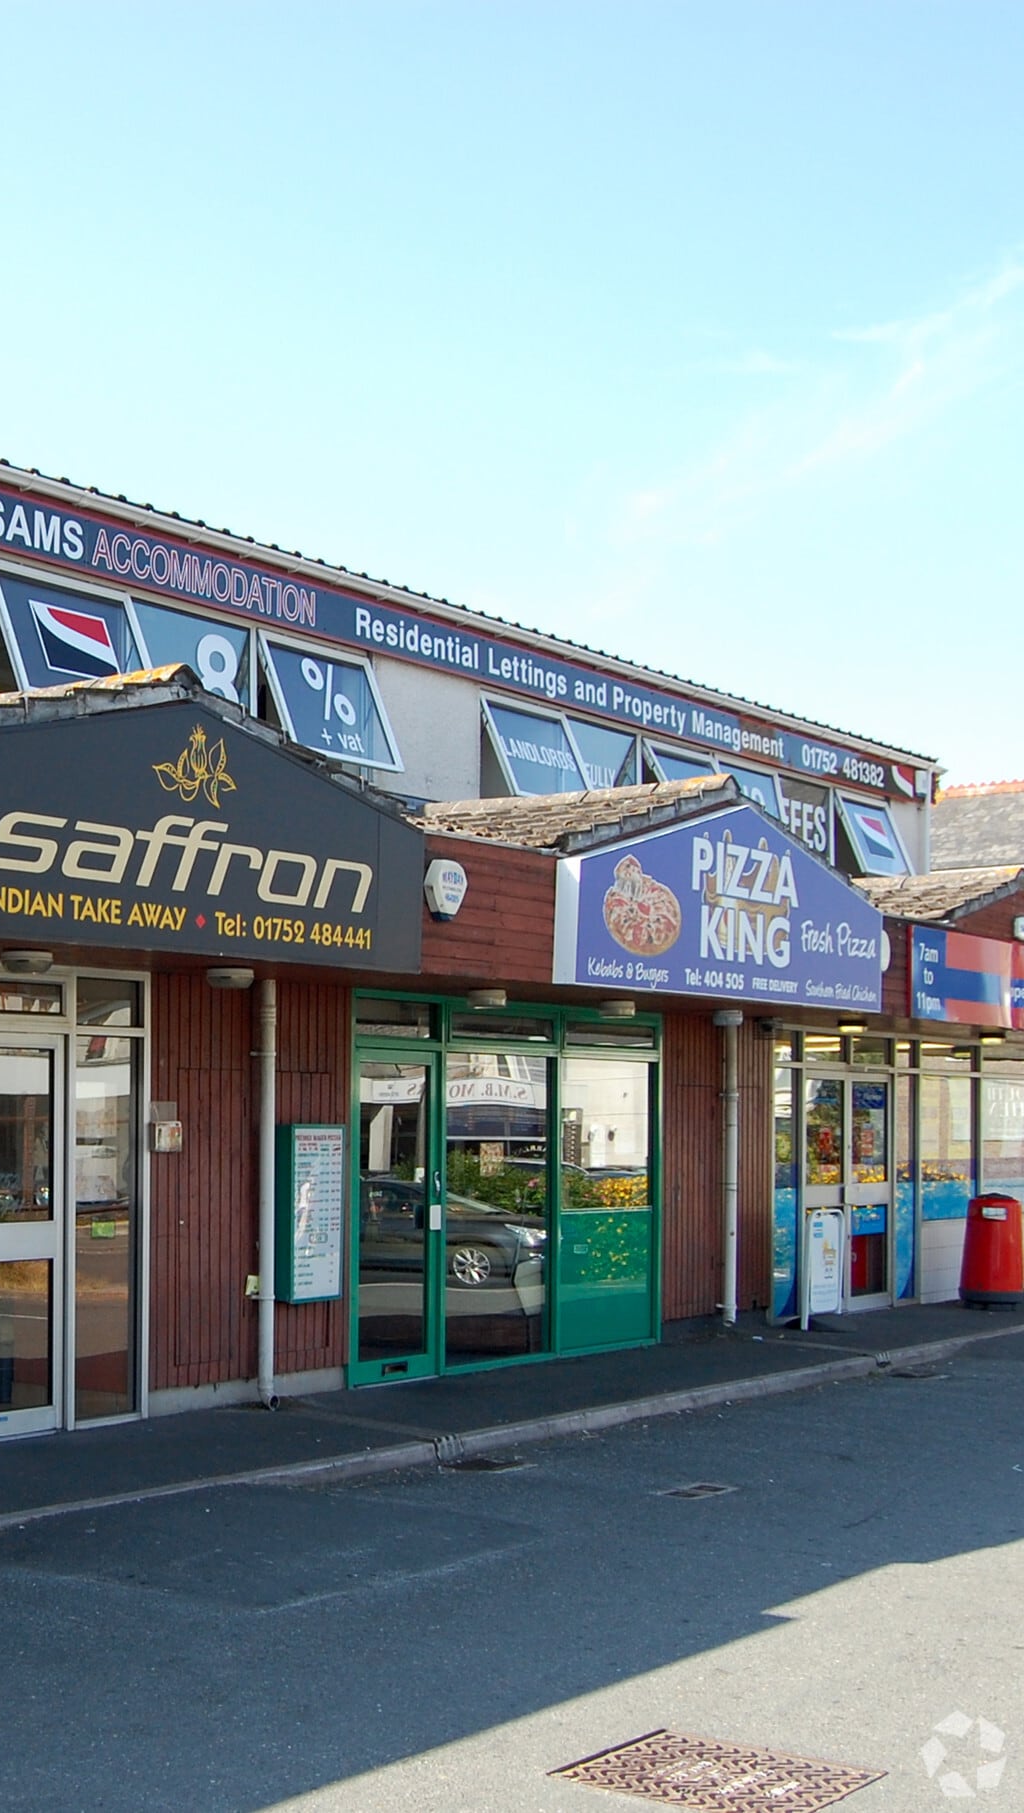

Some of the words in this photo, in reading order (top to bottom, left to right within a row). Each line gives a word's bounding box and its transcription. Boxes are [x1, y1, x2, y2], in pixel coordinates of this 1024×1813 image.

[92, 528, 317, 627] ACCOMMODATION
[355, 607, 479, 669] Residential
[488, 648, 568, 698] Lettings
[574, 679, 608, 707] and
[613, 686, 687, 736] Property
[692, 710, 785, 759] Management
[802, 744, 838, 775] 01752
[843, 757, 885, 788] 481382
[337, 731, 365, 753] vat
[499, 735, 576, 772] LANDLORDS
[691, 836, 799, 908] PIZZA
[70, 895, 122, 925] TAKE
[127, 903, 186, 931] AWAY
[215, 911, 247, 937] Tel:
[253, 916, 305, 943] 01752
[310, 922, 372, 950] 484441
[700, 905, 791, 968] KING
[800, 920, 834, 954] Fresh
[836, 922, 876, 959] Pizza
[919, 943, 939, 963] 7am
[588, 957, 624, 979] Kebabs
[635, 962, 669, 989] Burgers
[684, 968, 702, 986] Tel:
[704, 970, 724, 988] 404
[725, 972, 744, 990] 505
[752, 977, 768, 991] FREE
[769, 979, 798, 993] DELIVERY
[923, 967, 934, 985] to
[916, 991, 942, 1014] 11pm
